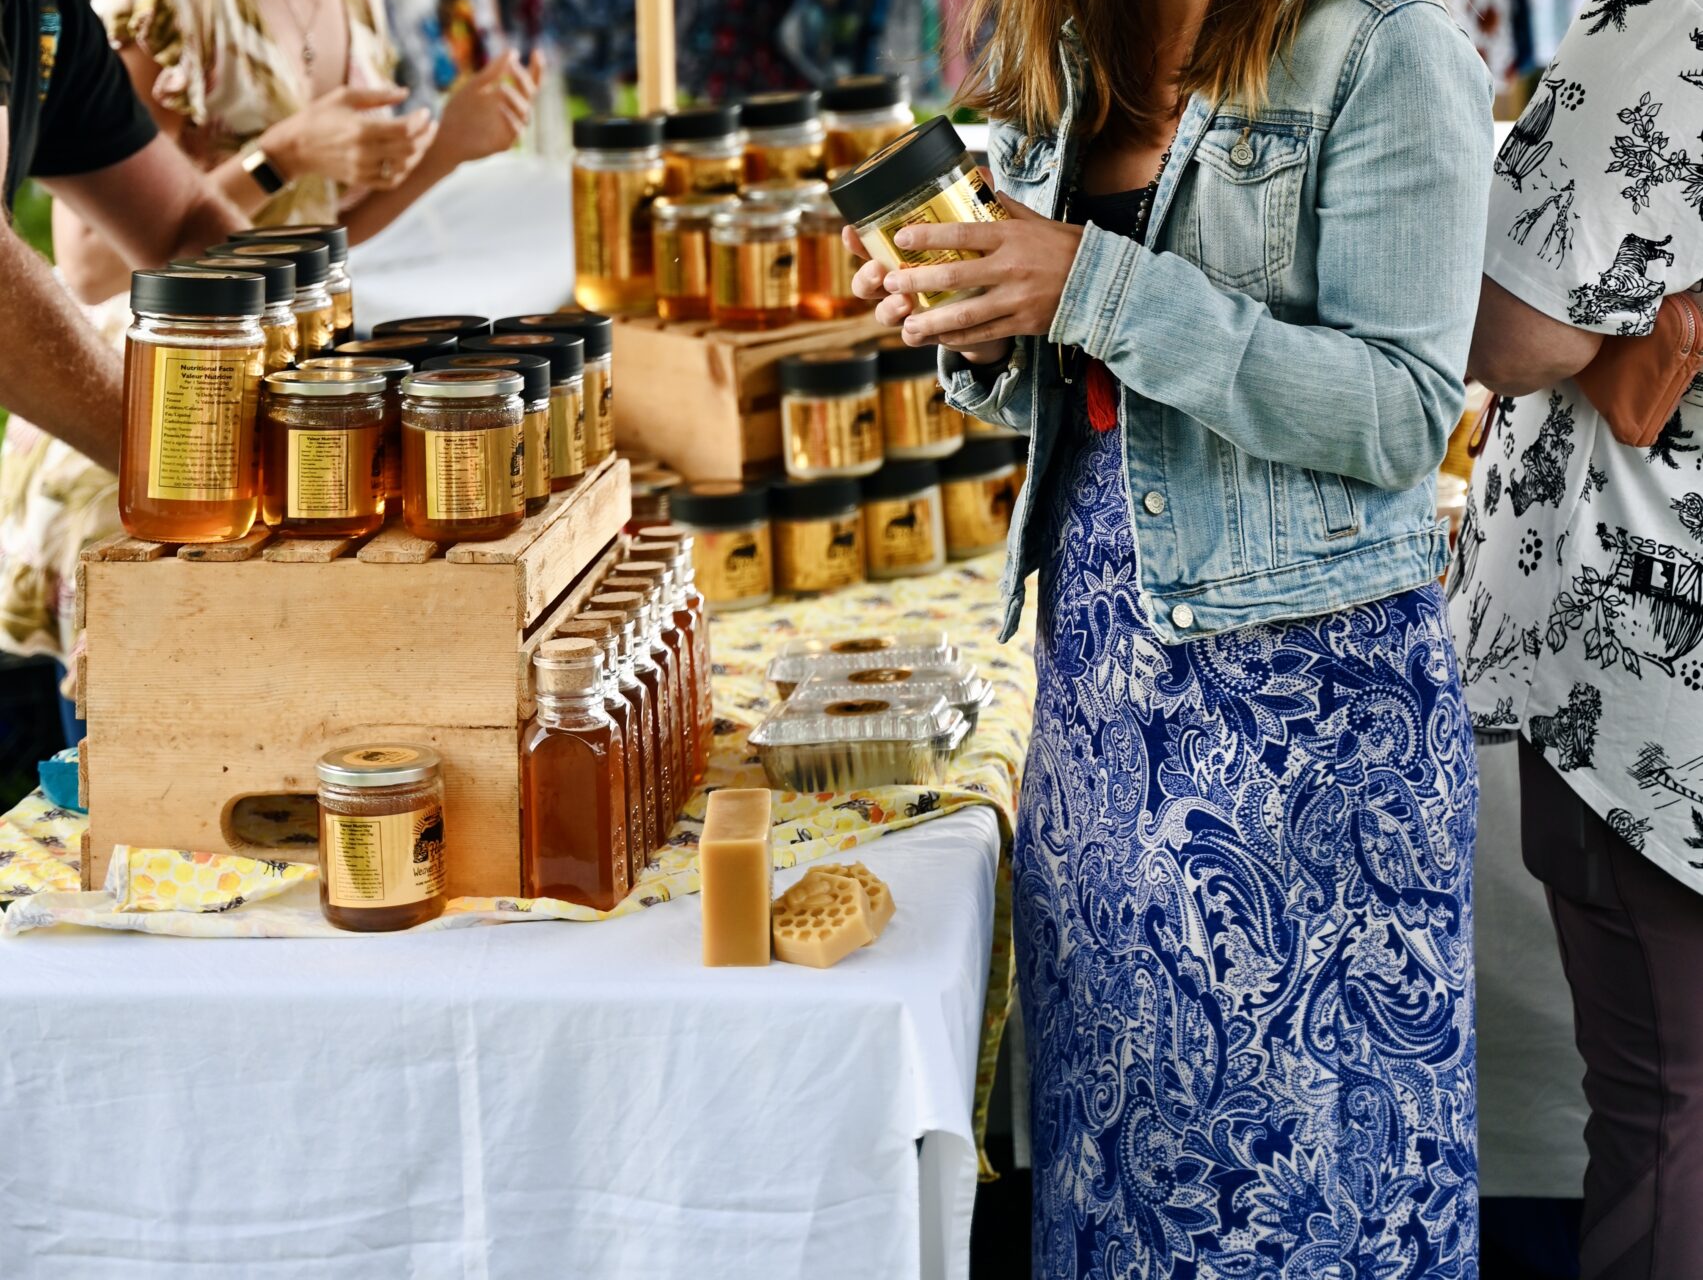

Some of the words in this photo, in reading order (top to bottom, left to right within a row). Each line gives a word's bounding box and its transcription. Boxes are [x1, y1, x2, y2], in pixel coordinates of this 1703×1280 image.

[180, 364, 217, 372] Nutritional
[181, 372, 203, 380] Valeur
[204, 373, 233, 381] Nutritive
